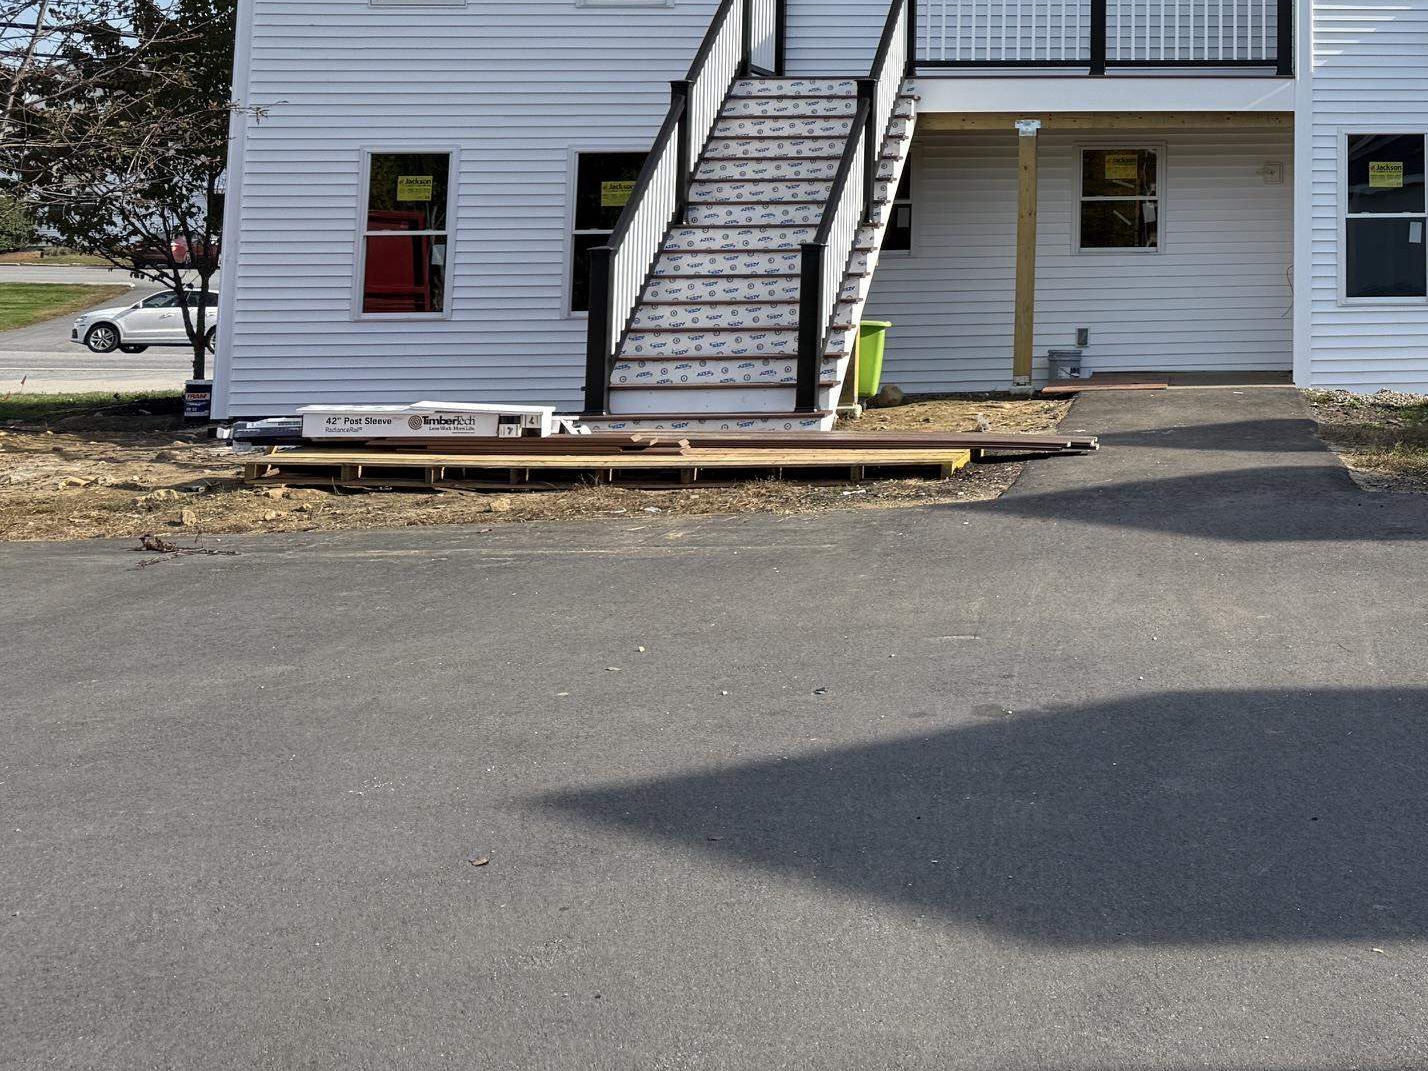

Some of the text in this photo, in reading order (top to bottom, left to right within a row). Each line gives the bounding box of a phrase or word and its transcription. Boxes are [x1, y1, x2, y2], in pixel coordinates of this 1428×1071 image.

[1376, 163, 1402, 171] Jackson
[364, 417, 392, 425] Sleeve
[422, 415, 475, 425] TimberTech
